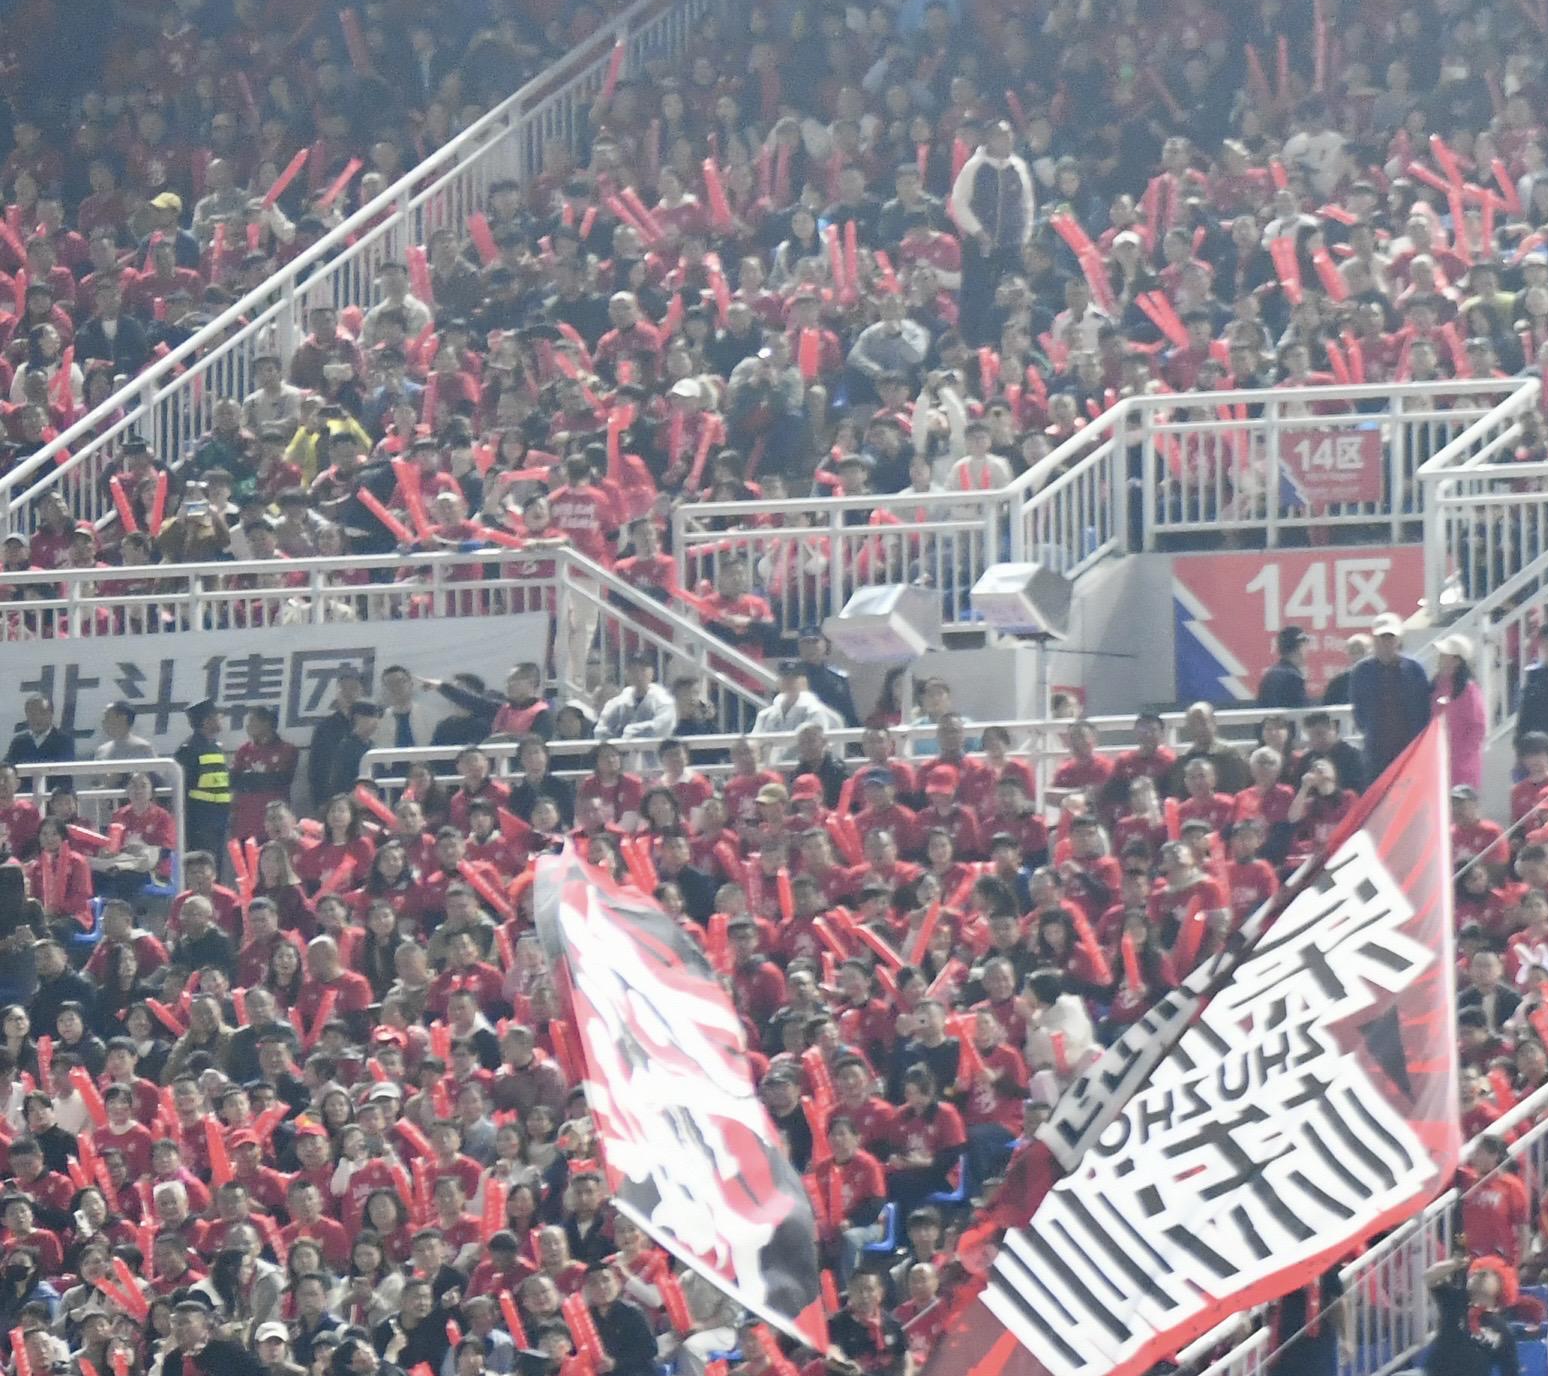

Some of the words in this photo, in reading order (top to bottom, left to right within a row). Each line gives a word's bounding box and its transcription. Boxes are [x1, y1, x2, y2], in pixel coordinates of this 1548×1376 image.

[1293, 436, 1366, 473] 14区
[1245, 557, 1393, 633] 14区
[19, 645, 377, 740] 北斗集团
